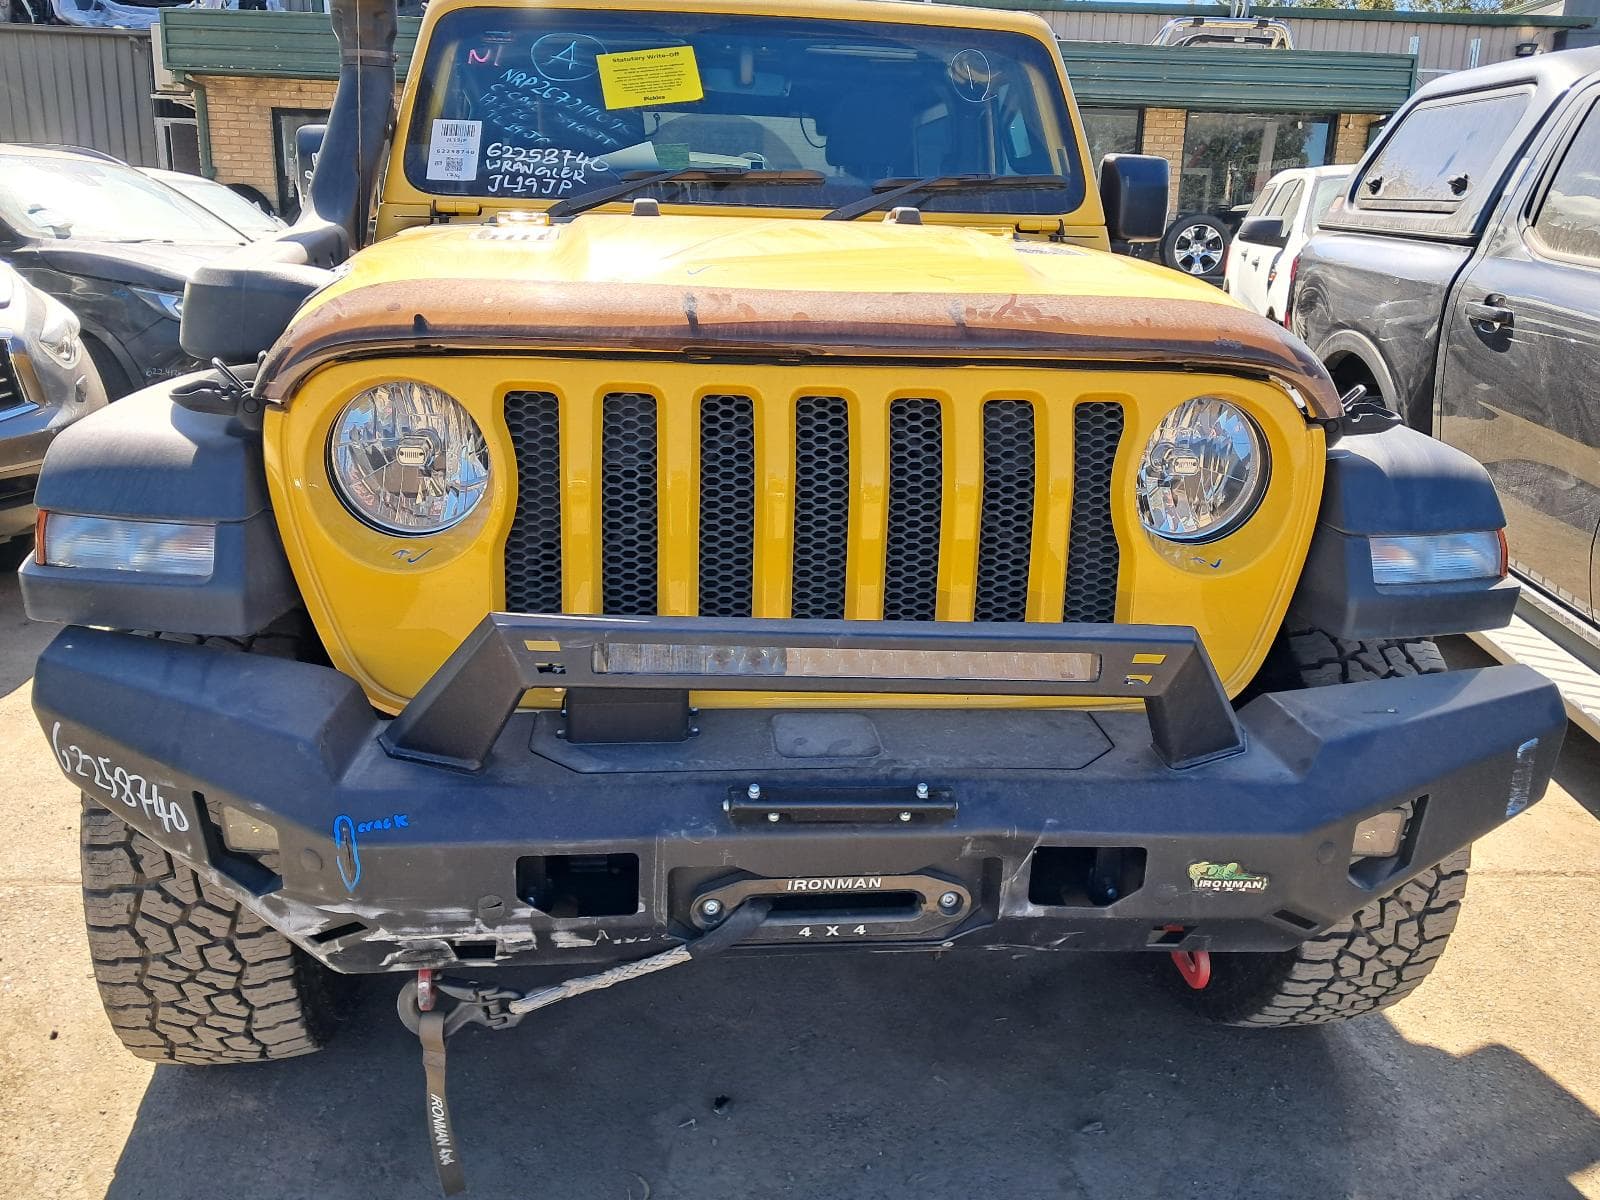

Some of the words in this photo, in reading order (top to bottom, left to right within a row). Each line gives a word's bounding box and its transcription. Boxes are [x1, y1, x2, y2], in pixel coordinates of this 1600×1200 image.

[646, 51, 680, 59] Write-Off
[485, 159, 587, 184] WRANGLER
[52, 721, 190, 833] 62258740
[786, 877, 882, 891] IRONMAN
[1198, 880, 1263, 889] IRONMAN
[430, 1092, 451, 1146] IRONMAN
